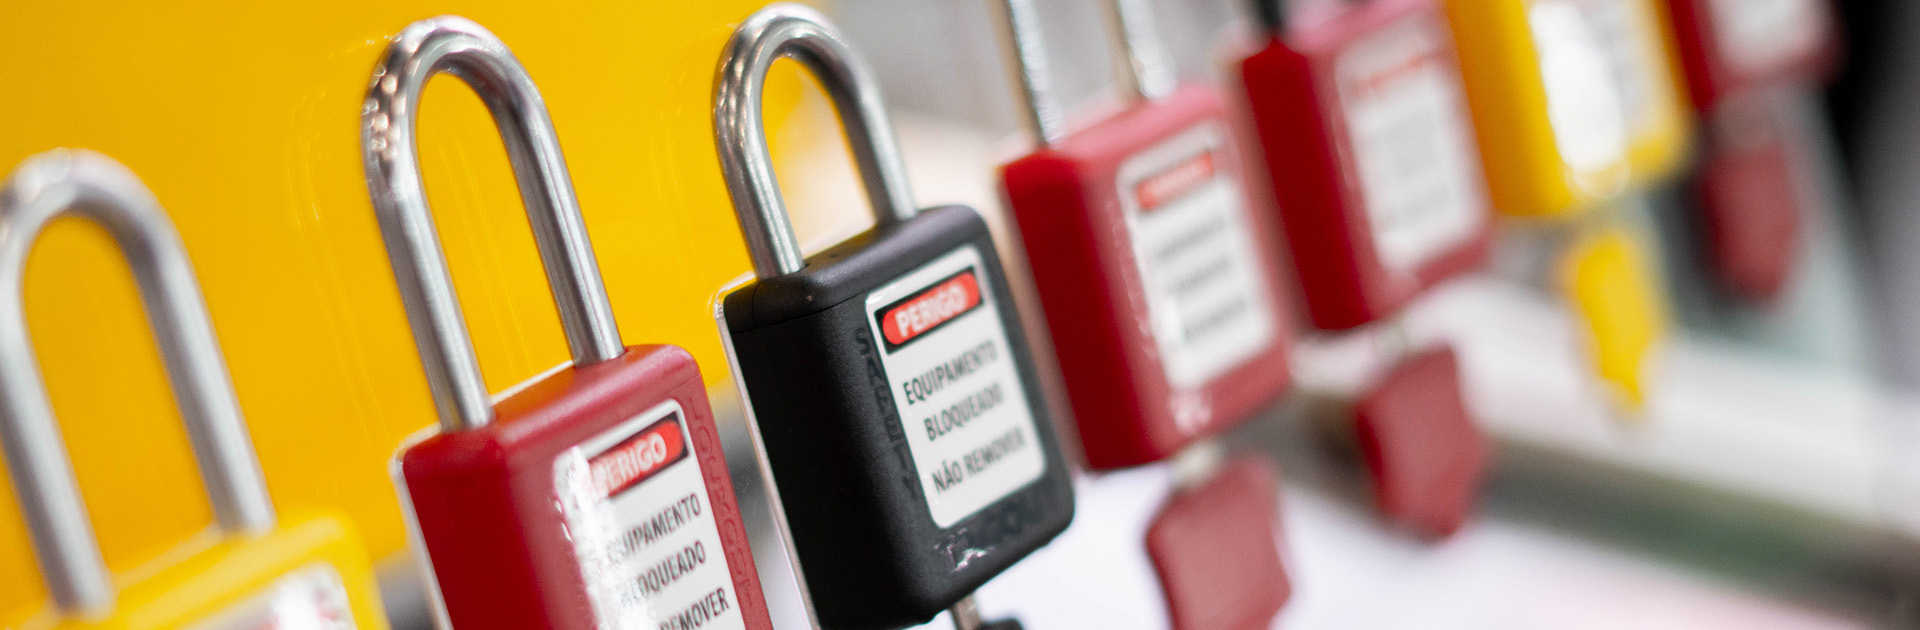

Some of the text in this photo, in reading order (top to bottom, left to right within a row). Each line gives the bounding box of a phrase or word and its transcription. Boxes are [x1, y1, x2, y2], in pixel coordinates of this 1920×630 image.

[895, 282, 968, 338] PERIGO
[903, 339, 998, 405] EQUIPAMENTO
[924, 382, 1004, 441] BLOQUEADO
[591, 431, 667, 499] PERIGO
[931, 461, 963, 494] NÃO
[603, 493, 701, 566] QUIPAMENTO
[617, 540, 706, 606] LOQUEADO
